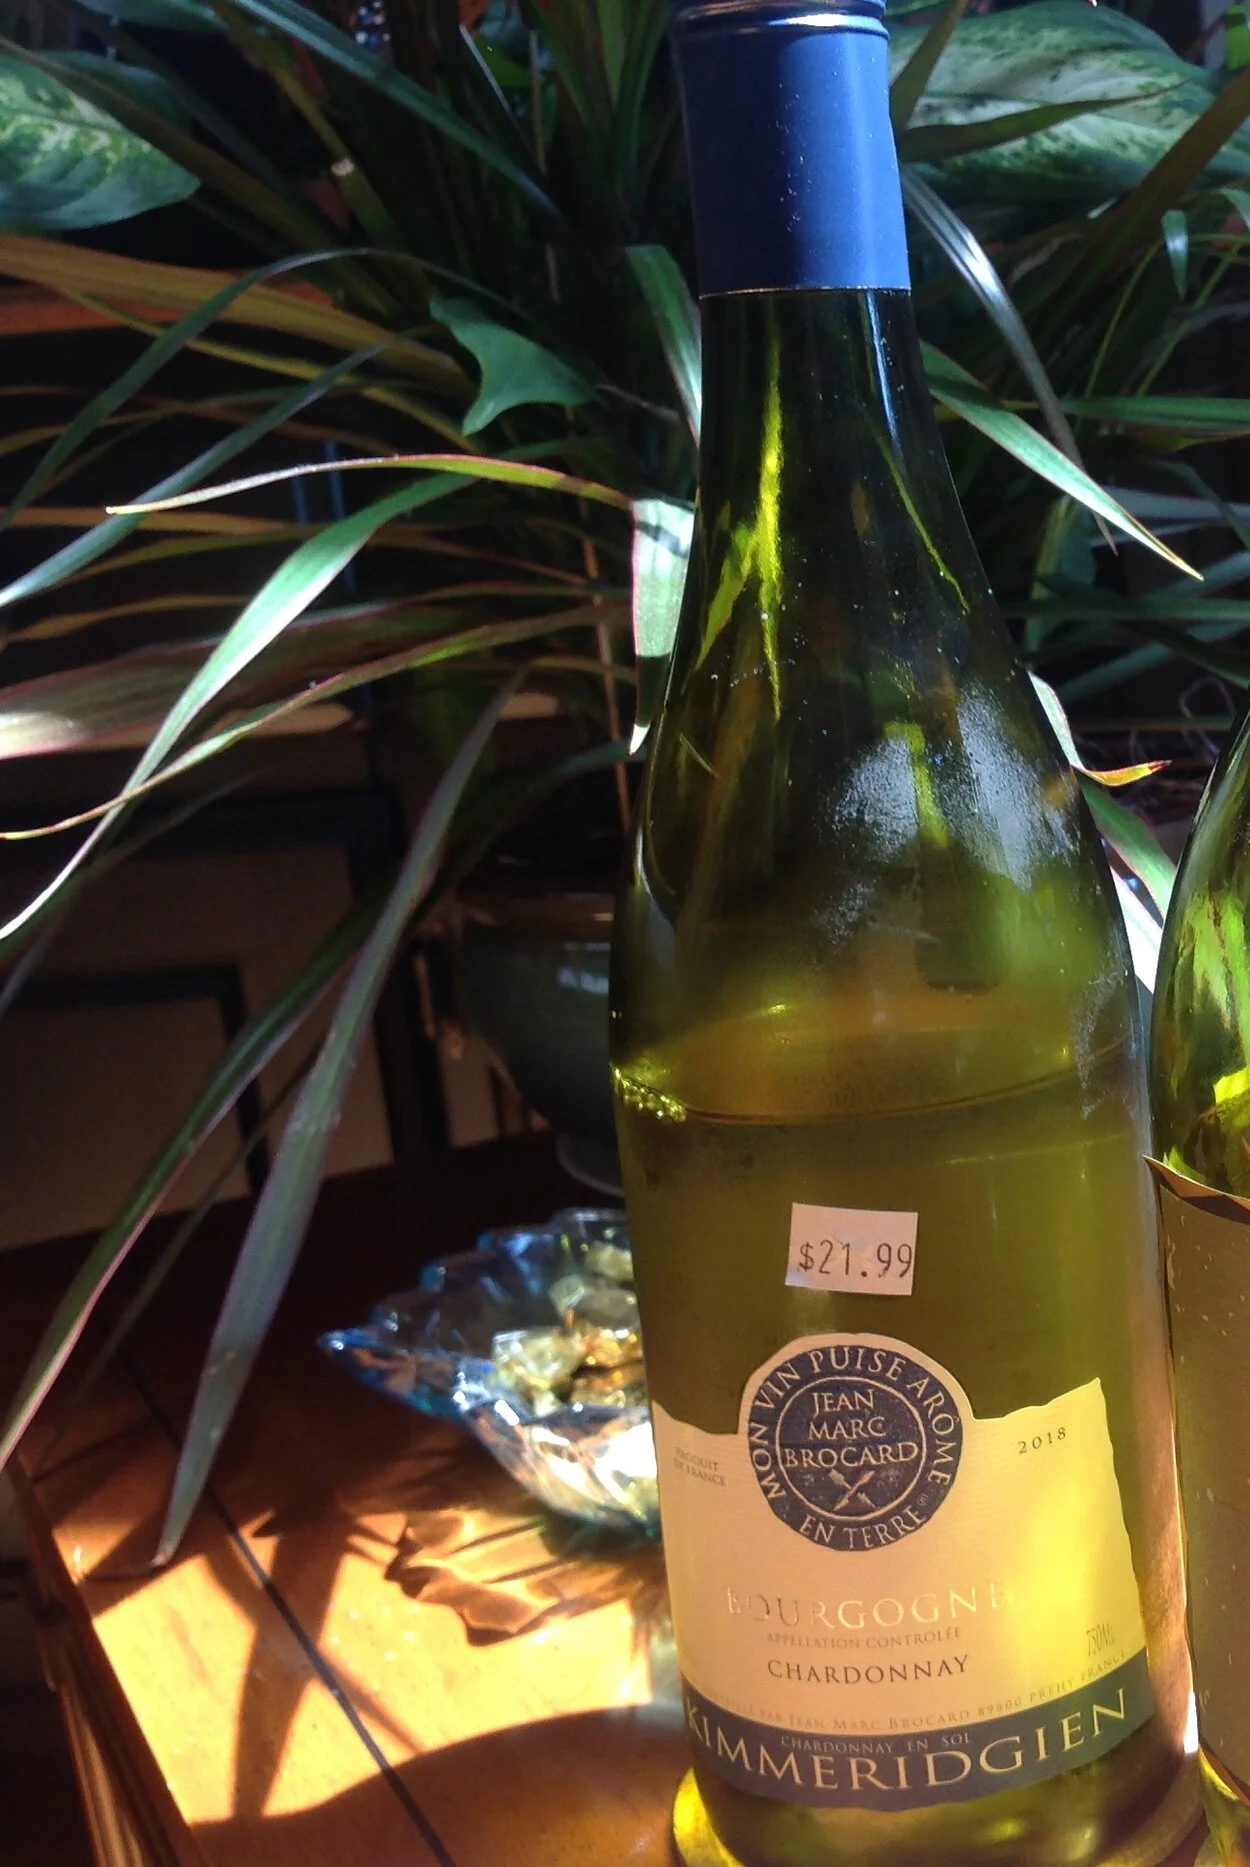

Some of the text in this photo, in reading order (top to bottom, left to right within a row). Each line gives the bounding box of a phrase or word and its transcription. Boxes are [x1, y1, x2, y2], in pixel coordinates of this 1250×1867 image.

[799, 1239, 912, 1278] $21.99
[811, 1389, 875, 1417] JEAN
[750, 1346, 961, 1499] MON VIN PUISE ARÔME
[807, 1416, 887, 1441] MARC
[1018, 1426, 1066, 1454] 2018
[785, 1441, 919, 1469] BROCARD
[800, 1505, 926, 1549] EN TERRE
[726, 1581, 1008, 1630] BOURGOGNE
[766, 1632, 861, 1650] APPELLATION
[766, 1653, 970, 1685] CHARDONNAY
[889, 1709, 971, 1730] BROCARD
[687, 1686, 1126, 1790] KIMMERIDGIEN
[780, 1731, 971, 1754] CHARDONNAY EN SOL
